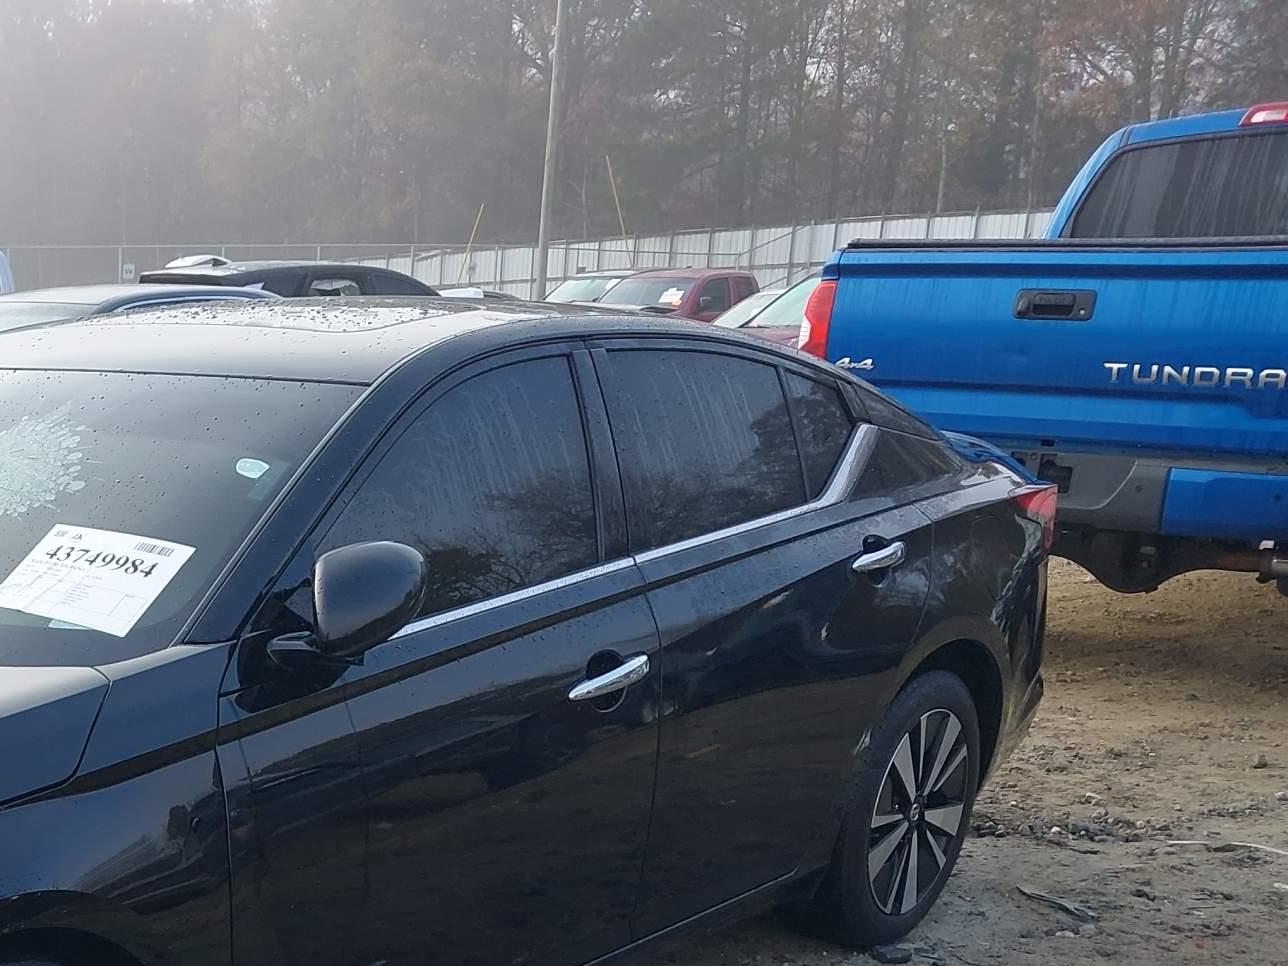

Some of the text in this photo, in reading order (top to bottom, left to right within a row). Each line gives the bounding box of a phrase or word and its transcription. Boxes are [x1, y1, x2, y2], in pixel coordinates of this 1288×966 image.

[835, 357, 875, 370] 4x4
[1103, 362, 1288, 391] TUNDRA
[45, 544, 159, 578] 43749984
